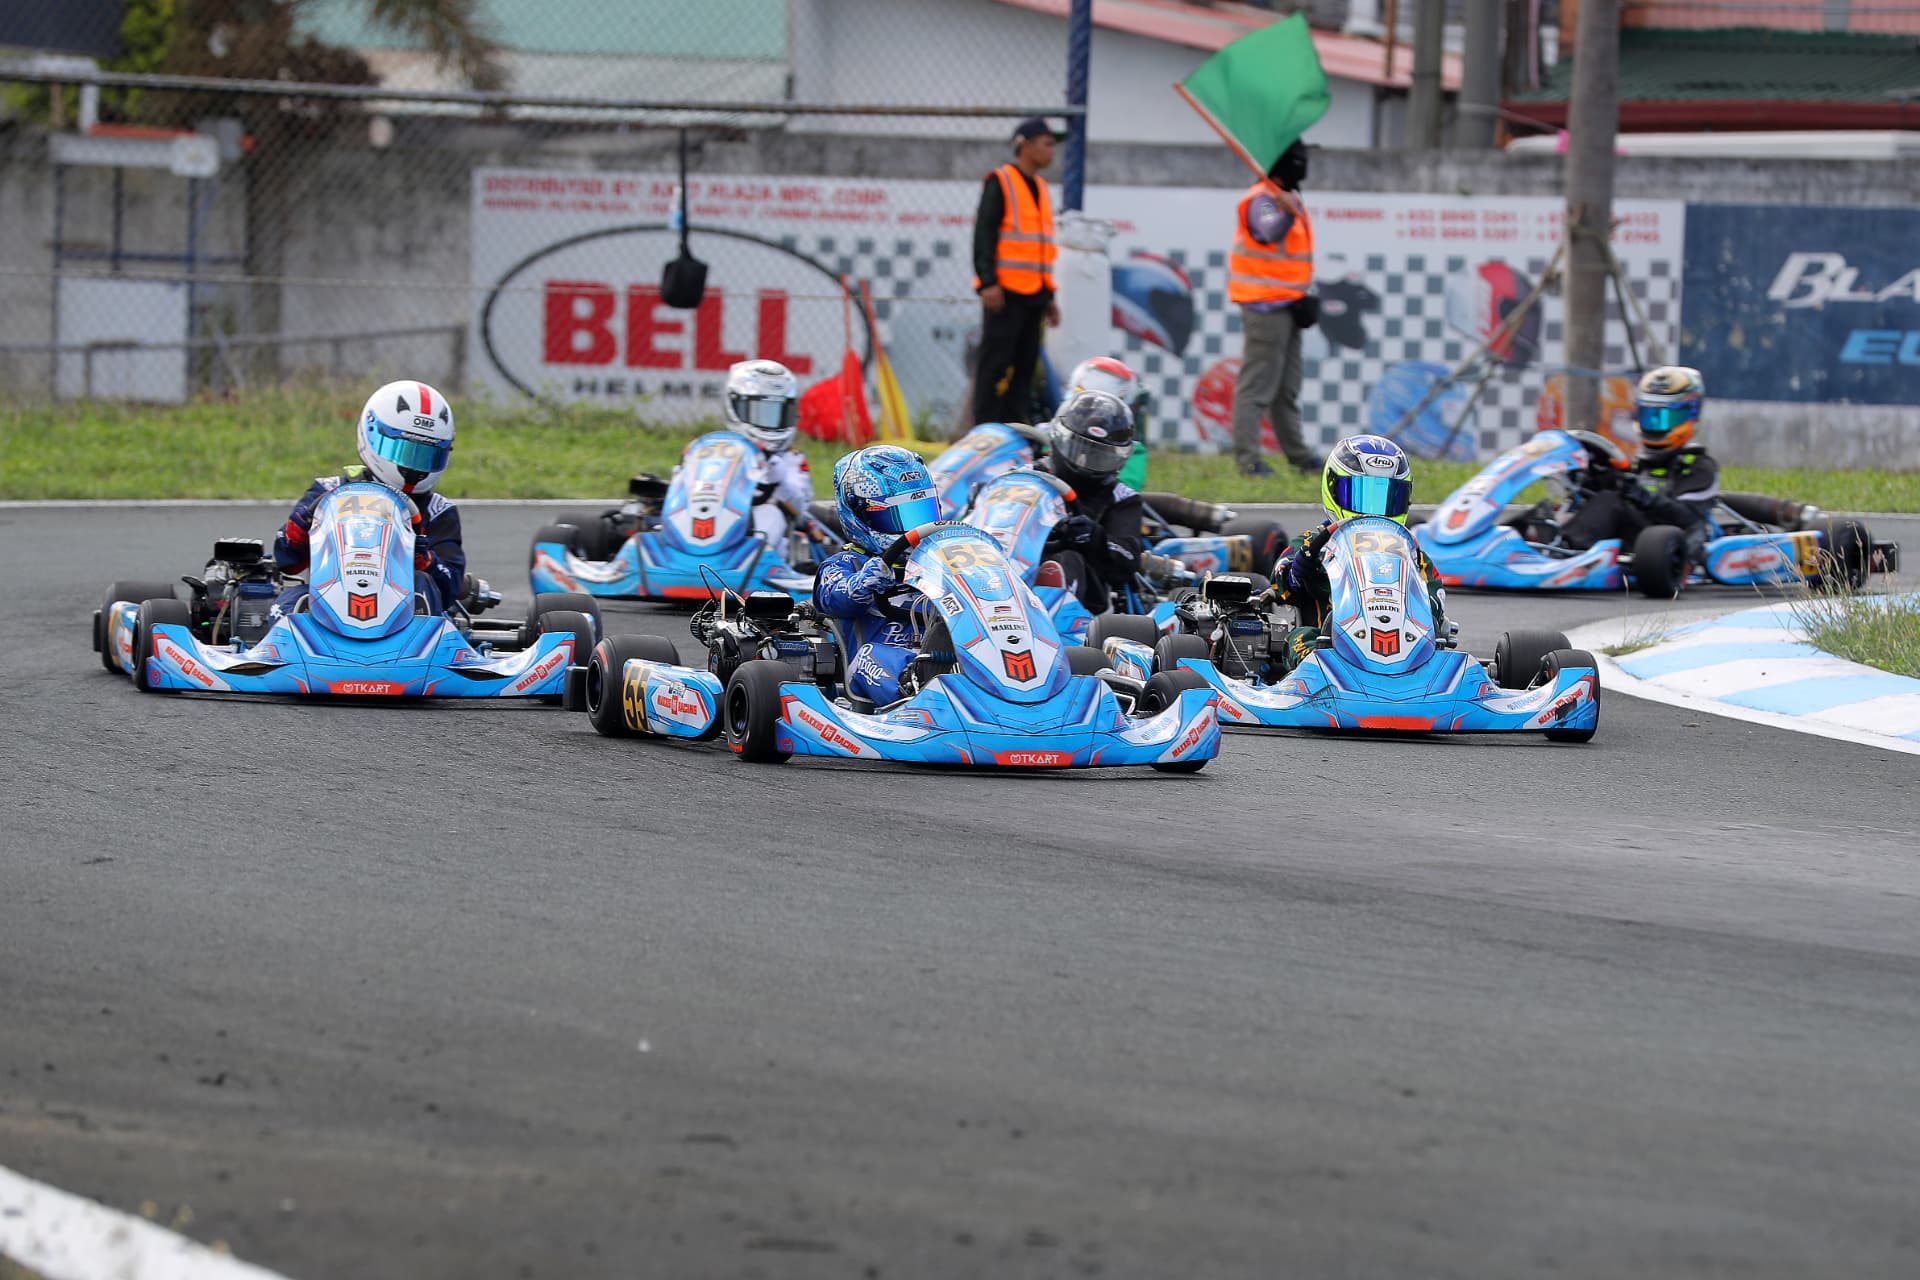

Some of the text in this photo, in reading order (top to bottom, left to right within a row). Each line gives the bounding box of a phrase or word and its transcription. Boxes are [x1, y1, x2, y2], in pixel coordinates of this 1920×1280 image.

[544, 281, 813, 375] BELL
[573, 378, 723, 398] HELME
[413, 417, 435, 429] OMP
[1370, 455, 1391, 466] Arai
[942, 545, 1007, 570] 55
[1354, 532, 1409, 560] 52
[625, 665, 650, 732] 55
